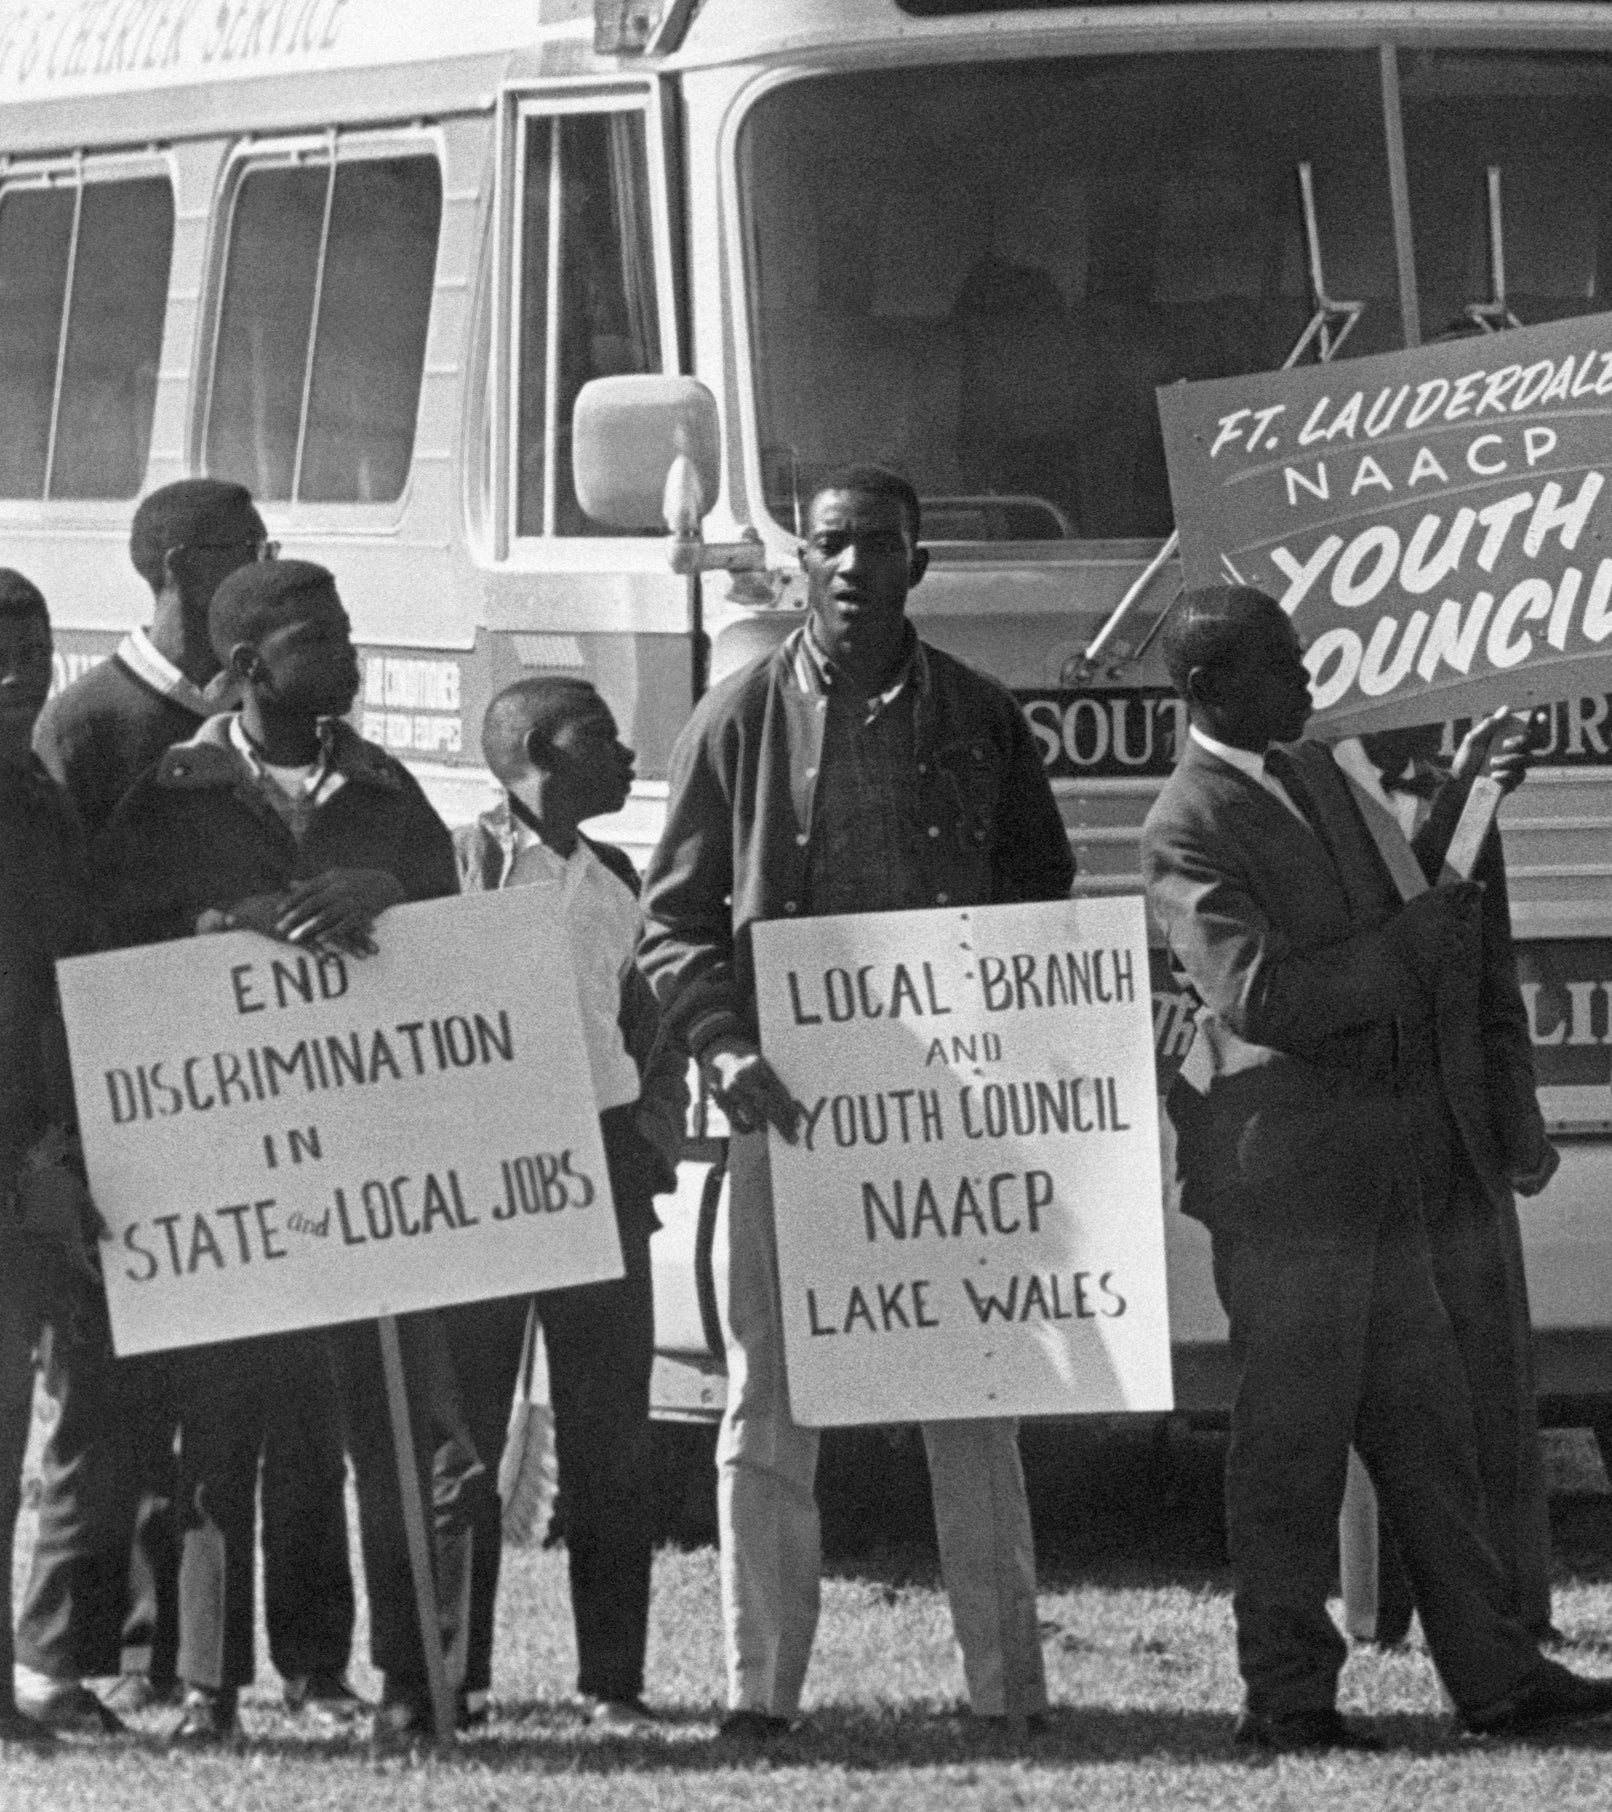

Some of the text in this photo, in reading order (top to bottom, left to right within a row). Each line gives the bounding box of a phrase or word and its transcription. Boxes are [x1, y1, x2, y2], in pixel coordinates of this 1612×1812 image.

[201, 0, 354, 64] SERVICE
[1209, 404, 1286, 458] FT.
[1270, 470, 1604, 617] YOUTH
[230, 952, 349, 1015] END
[787, 948, 1136, 1027] LOCAL BRANCH
[104, 1009, 515, 1125] DISCRIMINATION
[924, 1031, 1002, 1067] AND
[262, 1125, 323, 1169] IN
[799, 1075, 1132, 1152] YOUTH COUNCIL
[122, 1148, 595, 1283] STATE and LOCAL JOBS
[860, 1168, 1055, 1243] NAACP
[805, 1269, 1128, 1337] LAKE WALES
